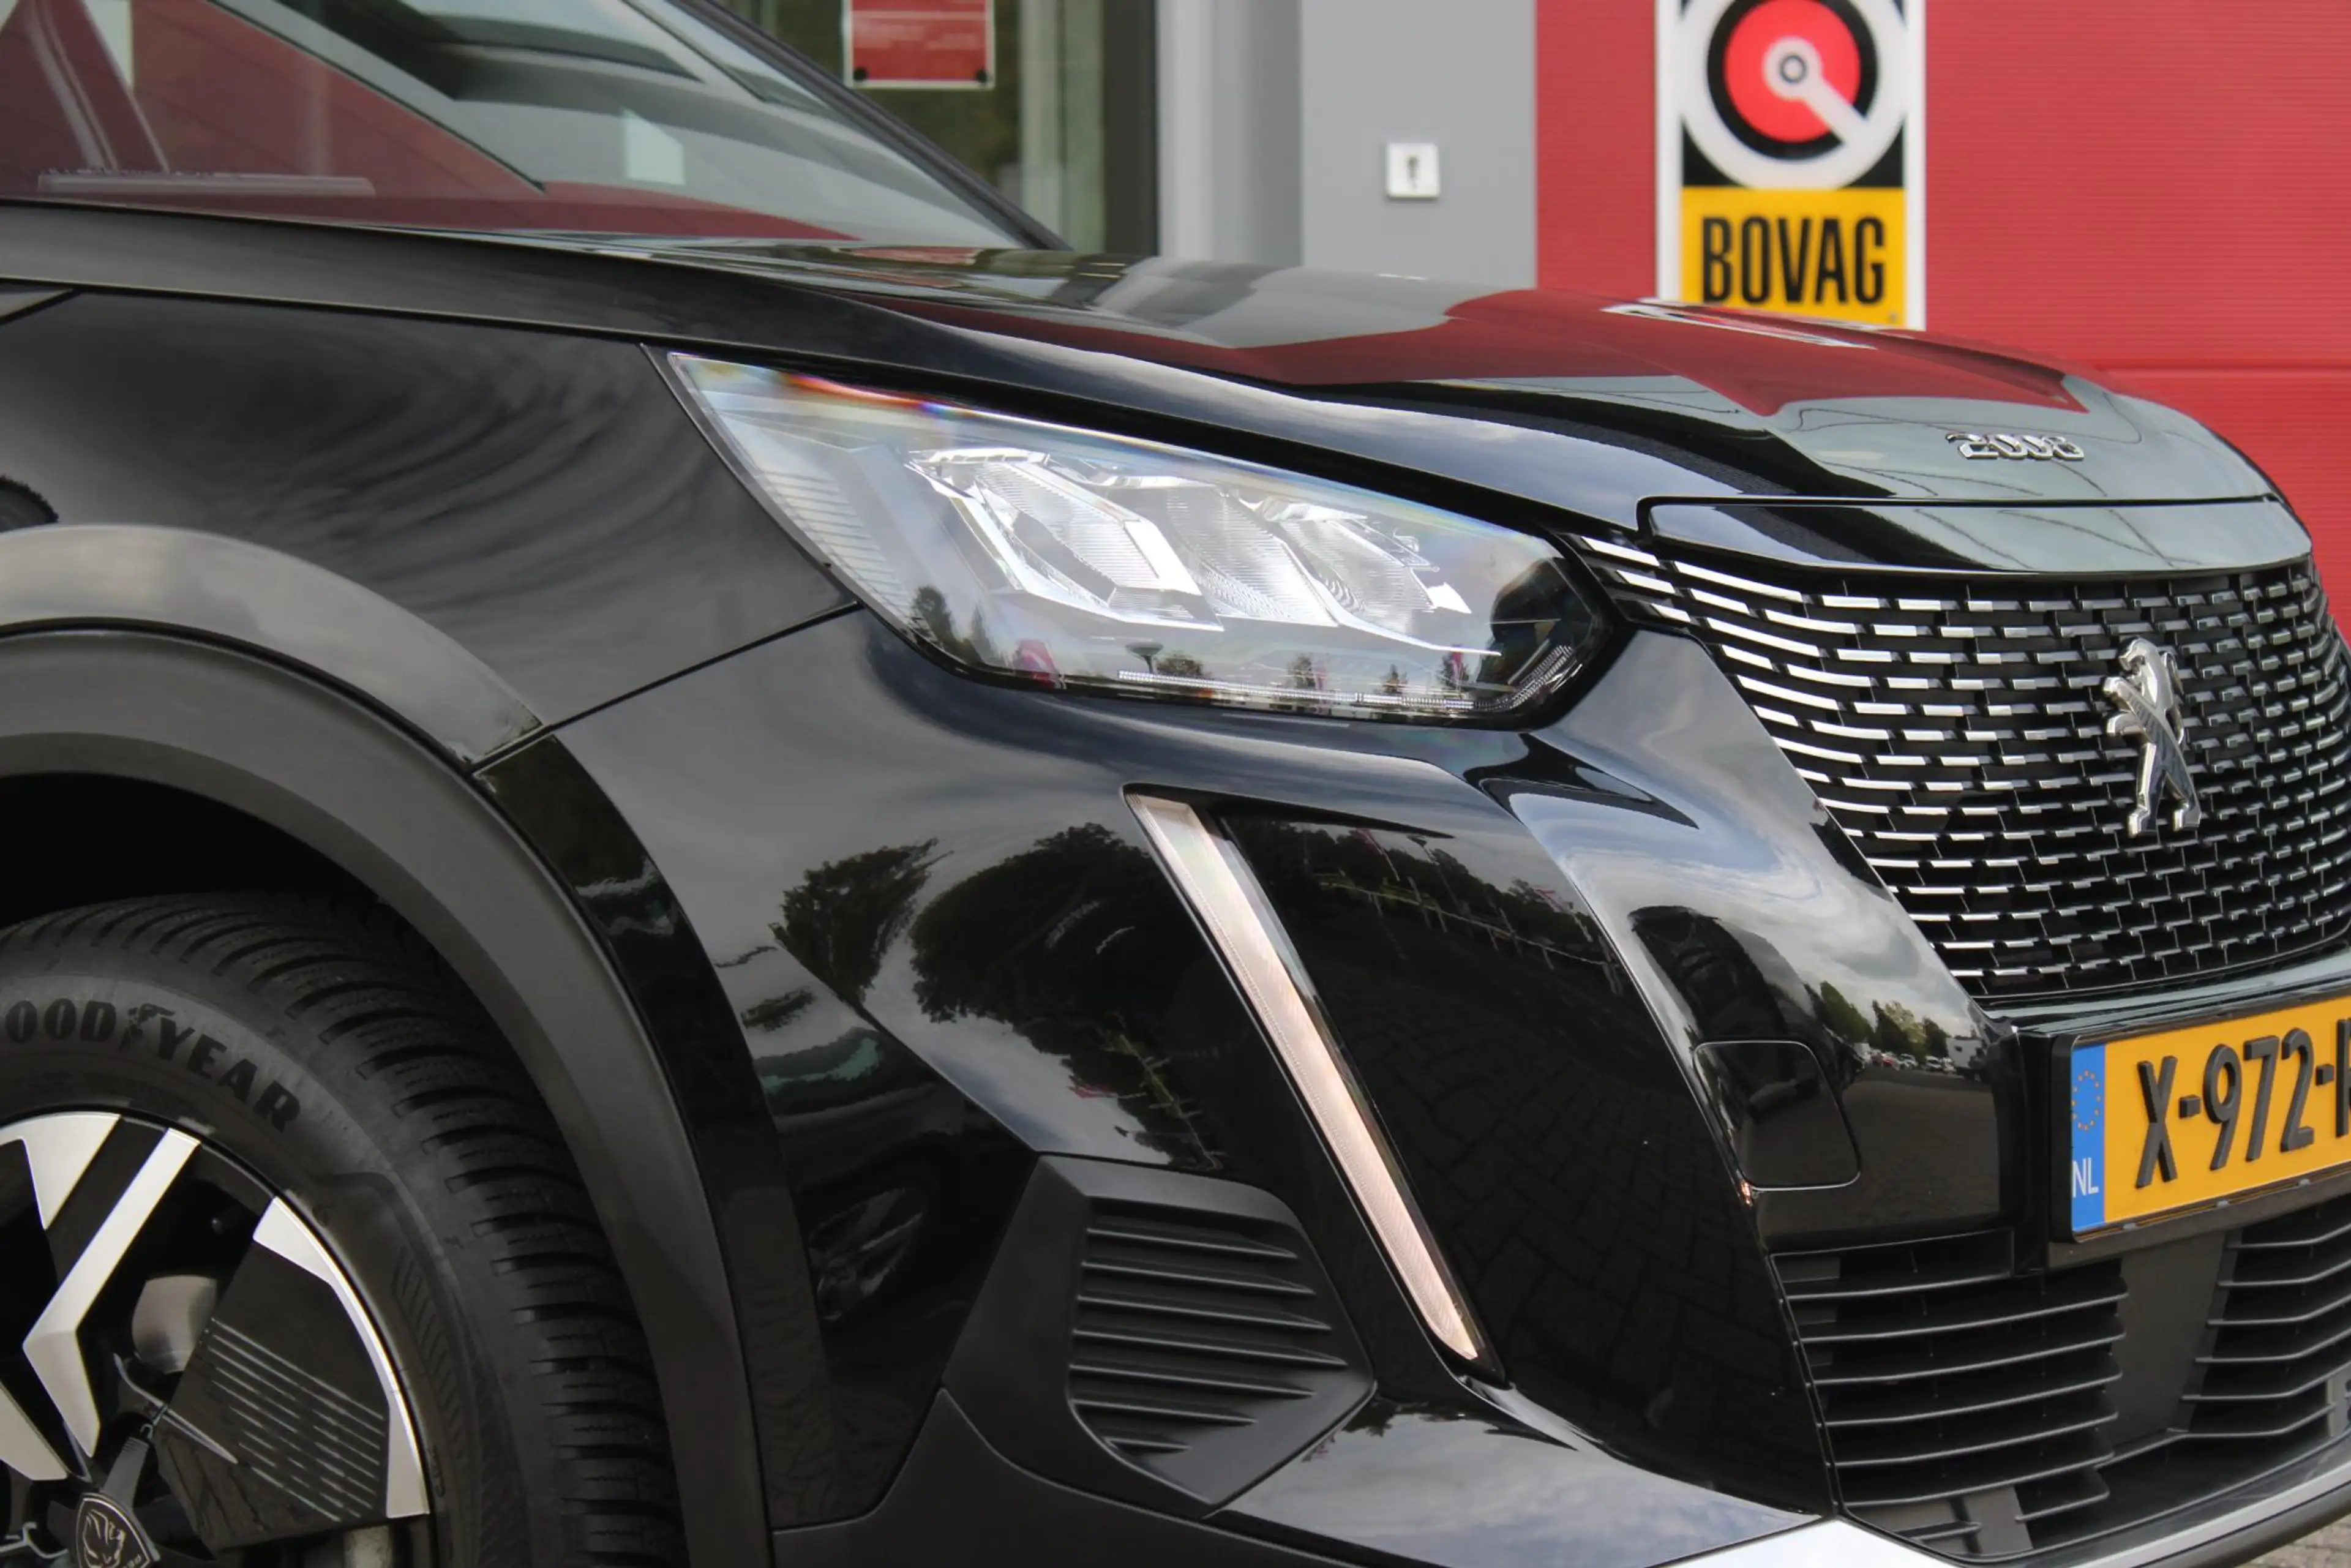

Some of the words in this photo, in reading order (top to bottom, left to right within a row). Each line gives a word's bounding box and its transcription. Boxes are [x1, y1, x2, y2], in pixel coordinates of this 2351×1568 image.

[1701, 216, 1884, 304] BOVAG
[1945, 432, 2085, 460] 2008
[2072, 1157, 2099, 1199] NL
